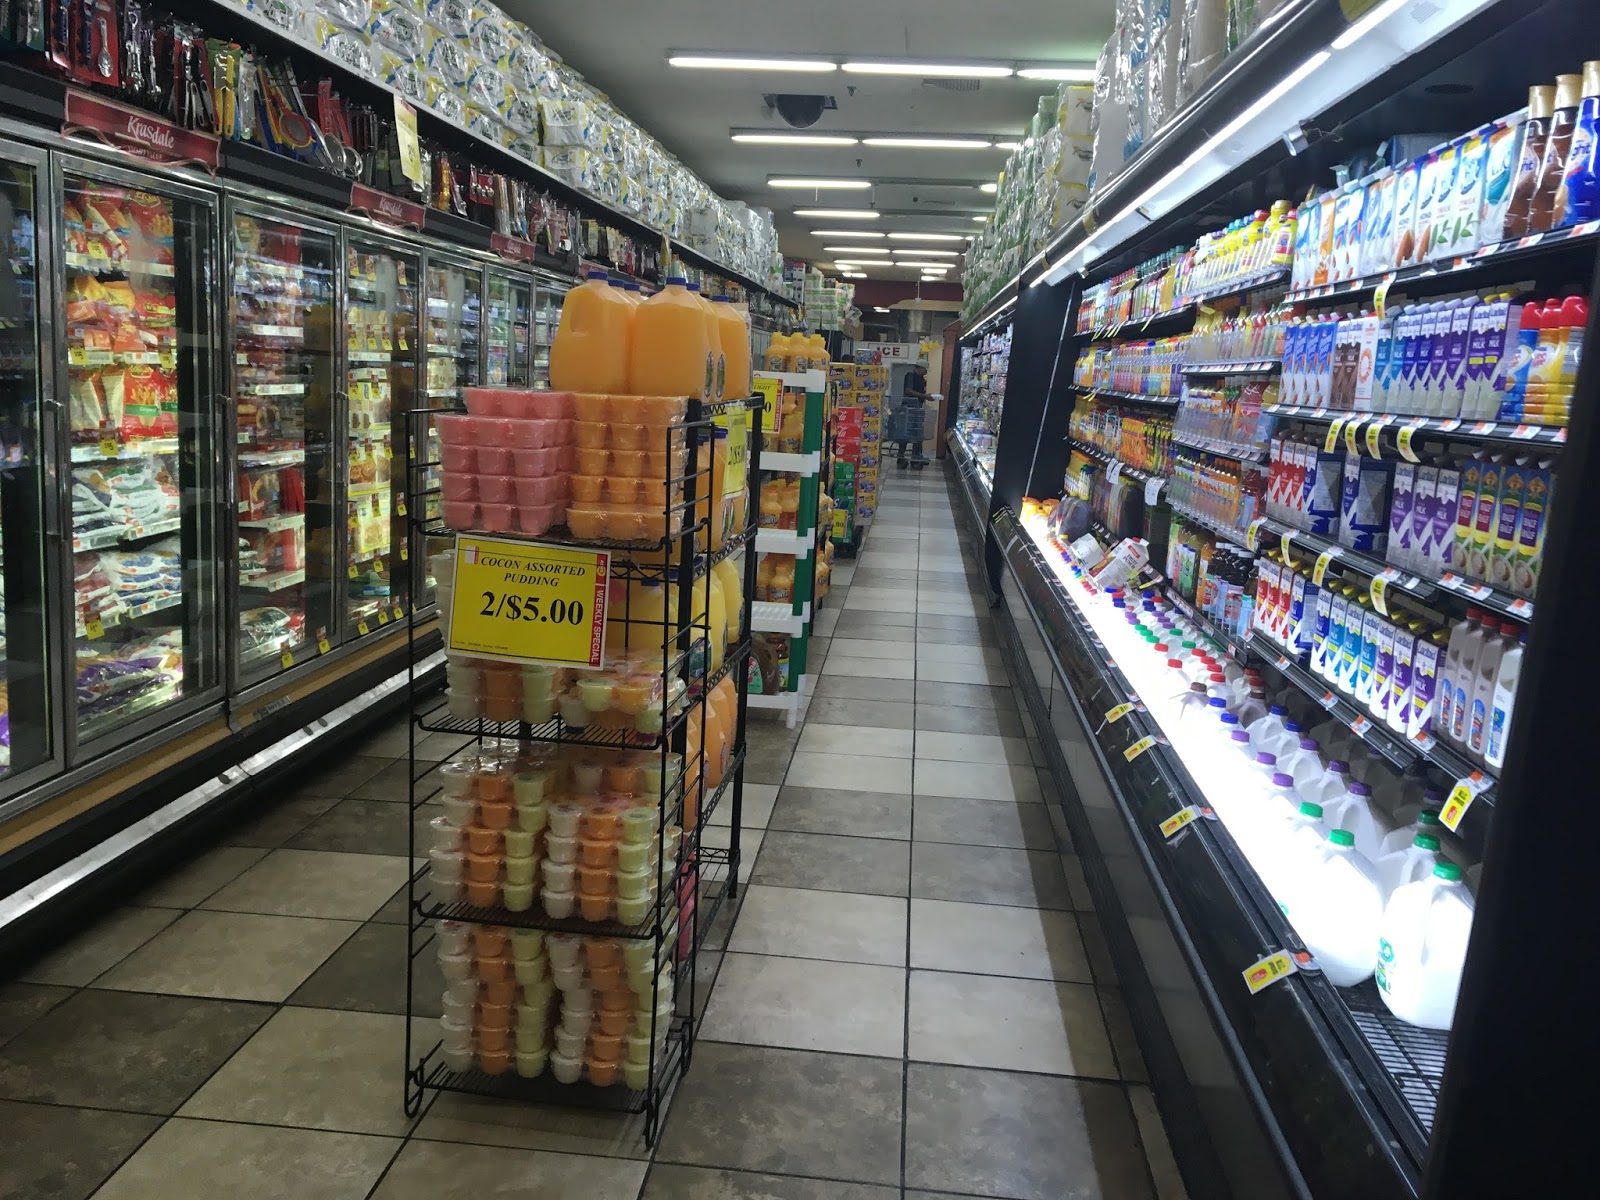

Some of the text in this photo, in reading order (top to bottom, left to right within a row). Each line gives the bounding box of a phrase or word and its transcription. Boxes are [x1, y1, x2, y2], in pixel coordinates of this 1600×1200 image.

[127, 116, 175, 149] Krasdale
[480, 556, 522, 570] COCON
[523, 562, 586, 577] ASSORTED
[503, 572, 560, 587] PUDDING
[480, 591, 584, 626] 2/$5.00
[591, 589, 604, 663] WEEKLY SPECIAL
